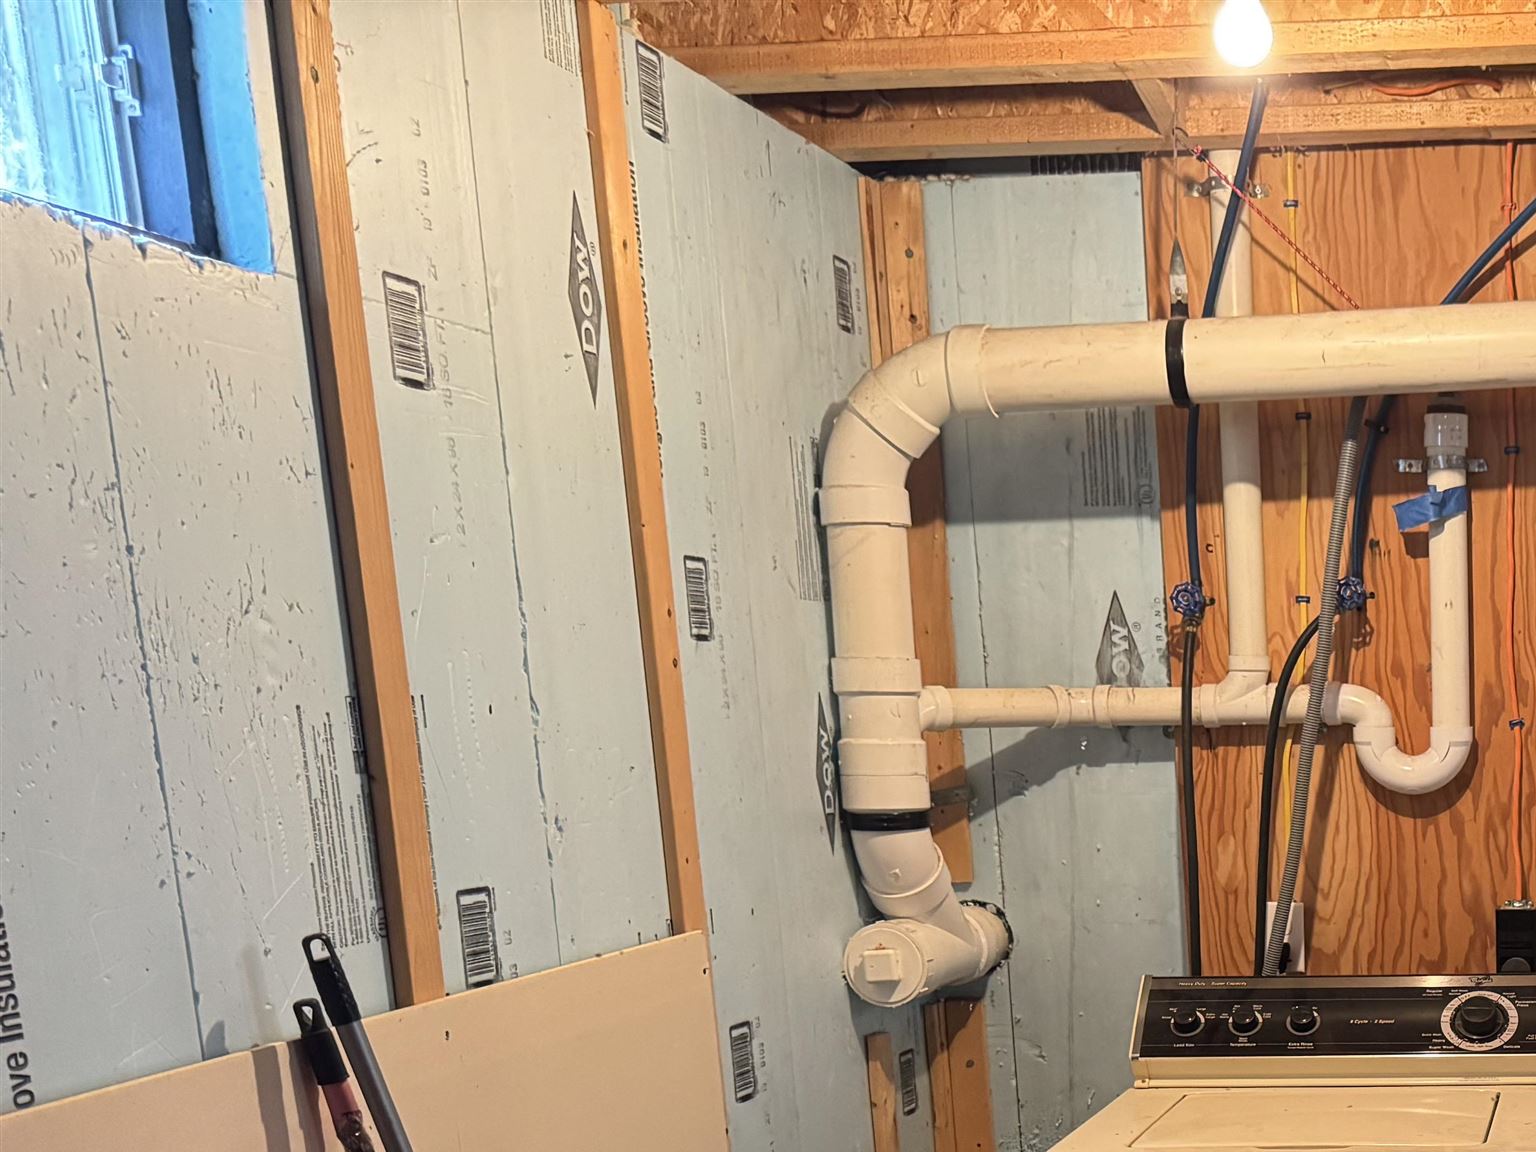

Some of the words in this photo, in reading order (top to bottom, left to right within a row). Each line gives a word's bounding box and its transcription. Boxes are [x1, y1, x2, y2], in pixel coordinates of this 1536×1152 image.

[574, 229, 598, 357] DOW
[1109, 620, 1130, 678] OW
[818, 725, 835, 814] DOW
[5, 1052, 36, 1109] ove
